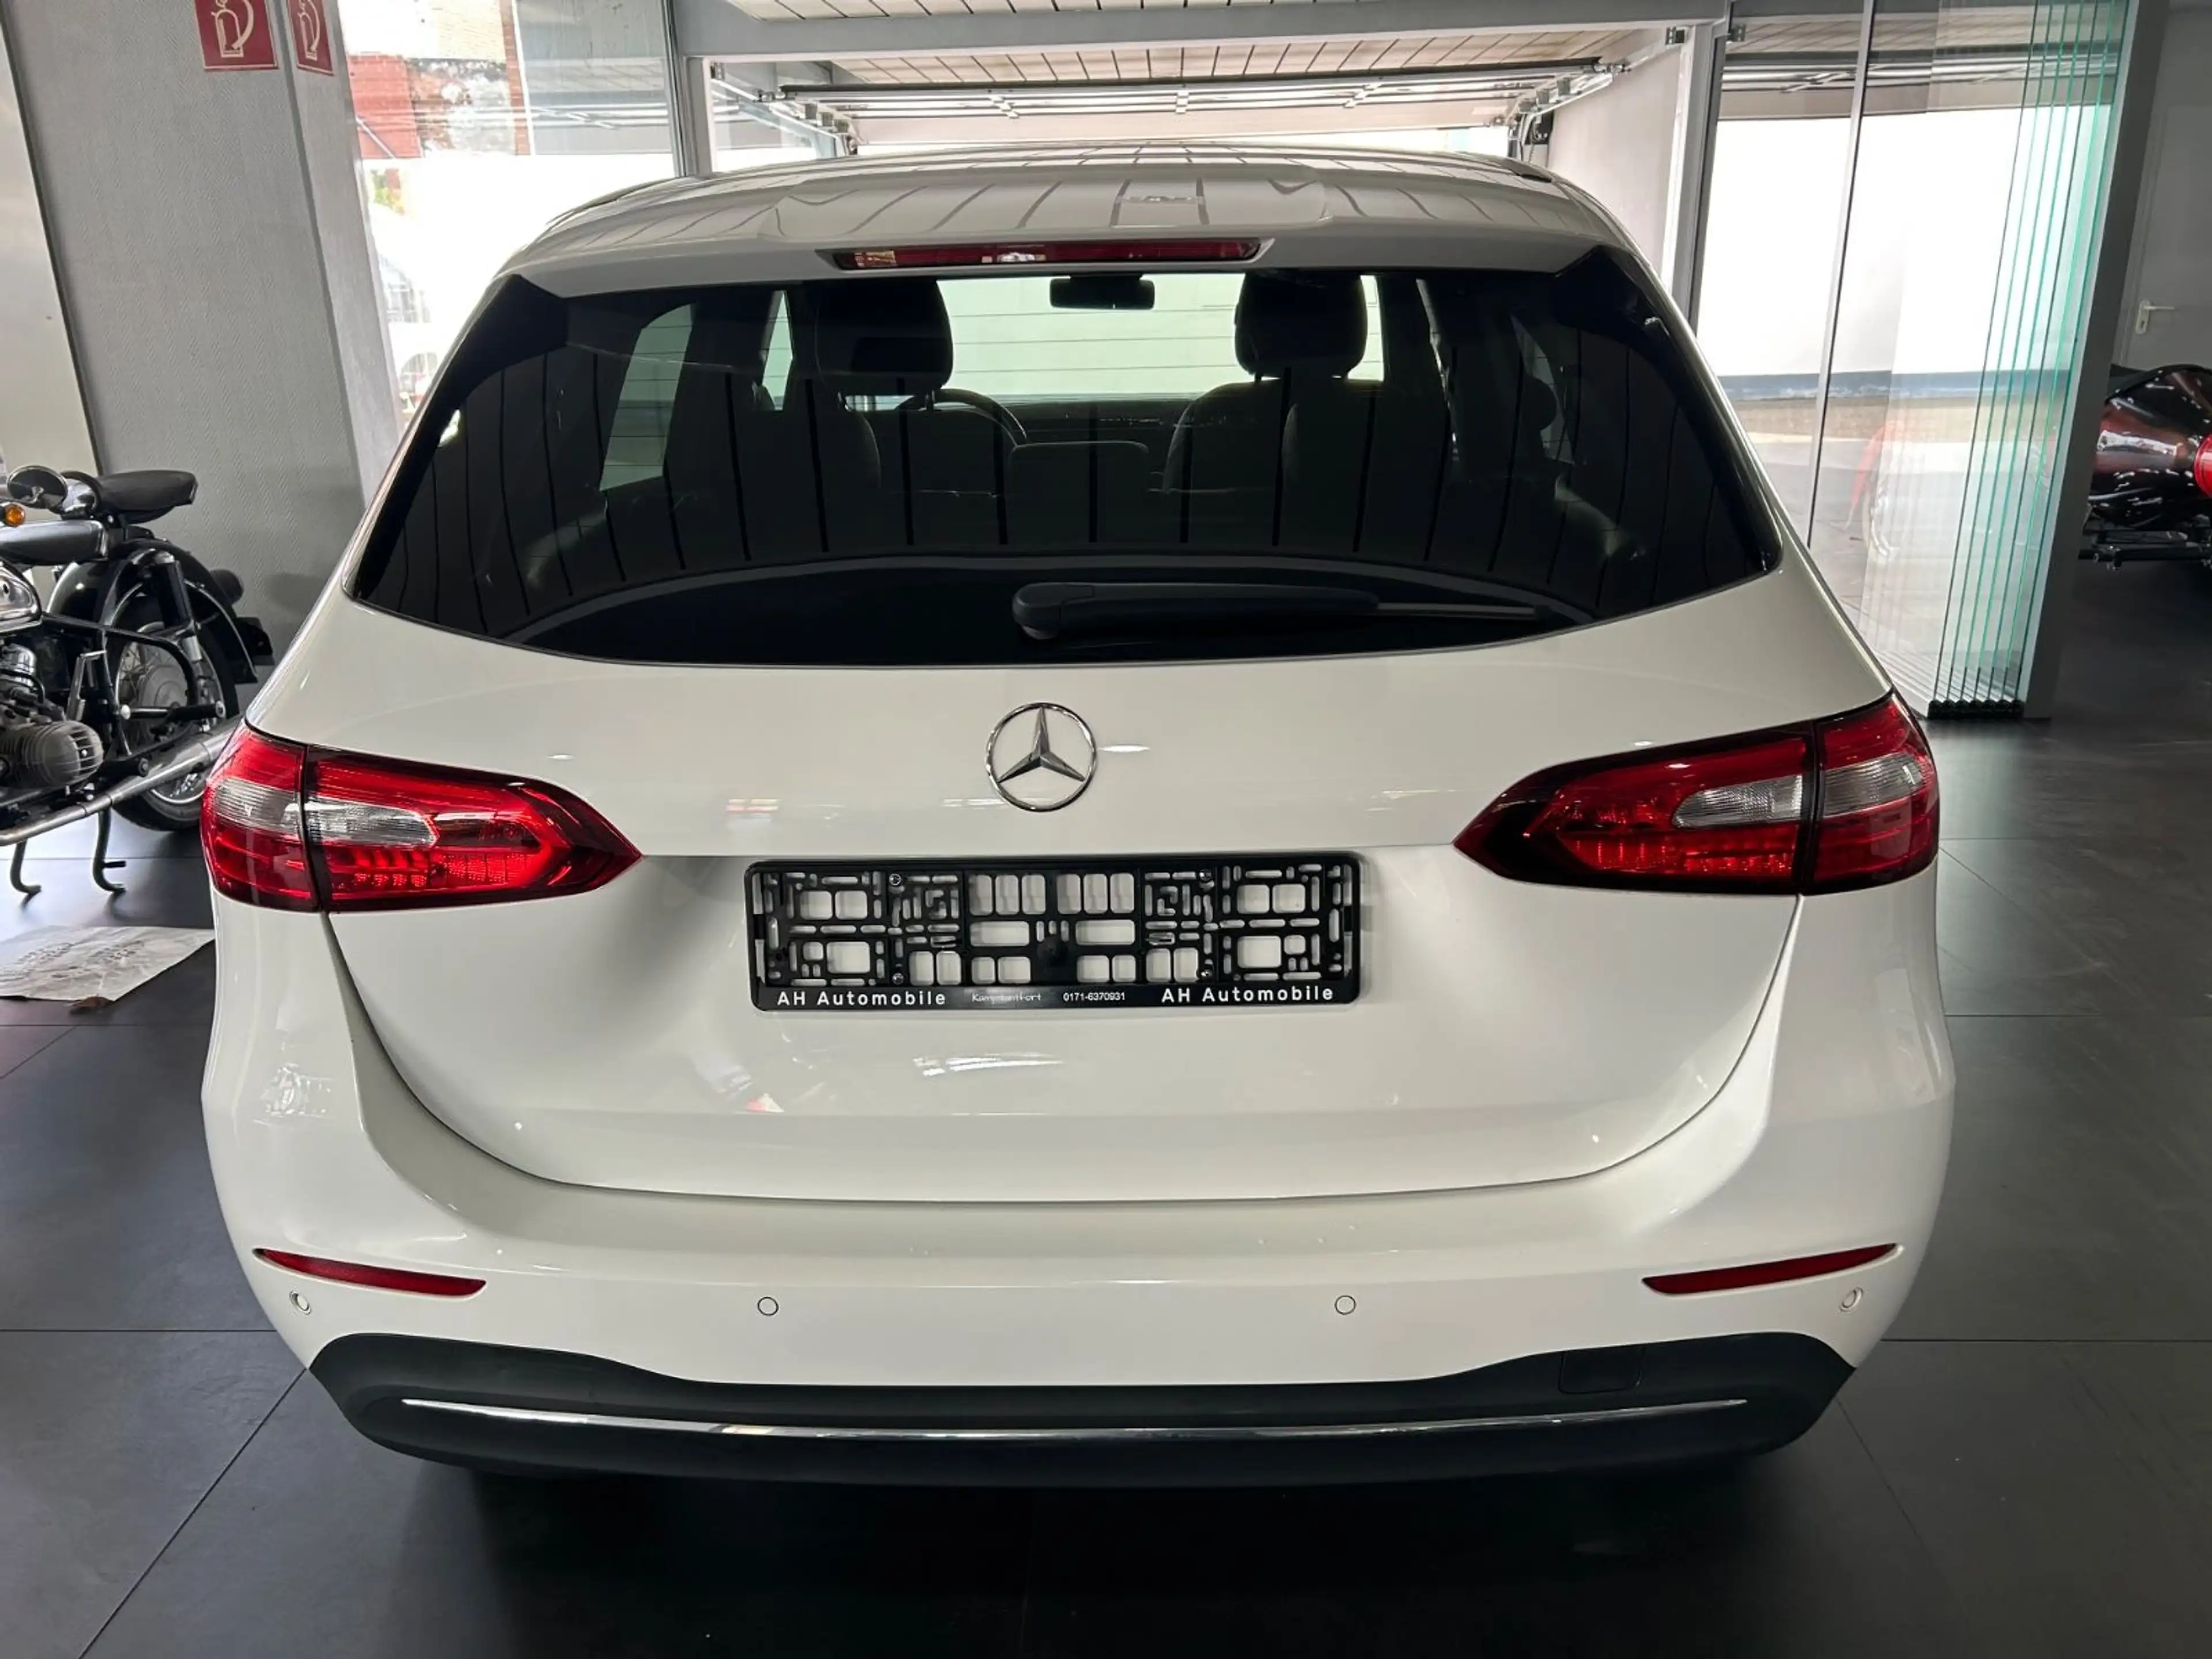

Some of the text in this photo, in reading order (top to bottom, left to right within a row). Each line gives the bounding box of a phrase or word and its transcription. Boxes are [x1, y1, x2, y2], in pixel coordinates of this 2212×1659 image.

[777, 990, 946, 1006] AH Automobile
[1161, 986, 1334, 1003] AH Automobile
